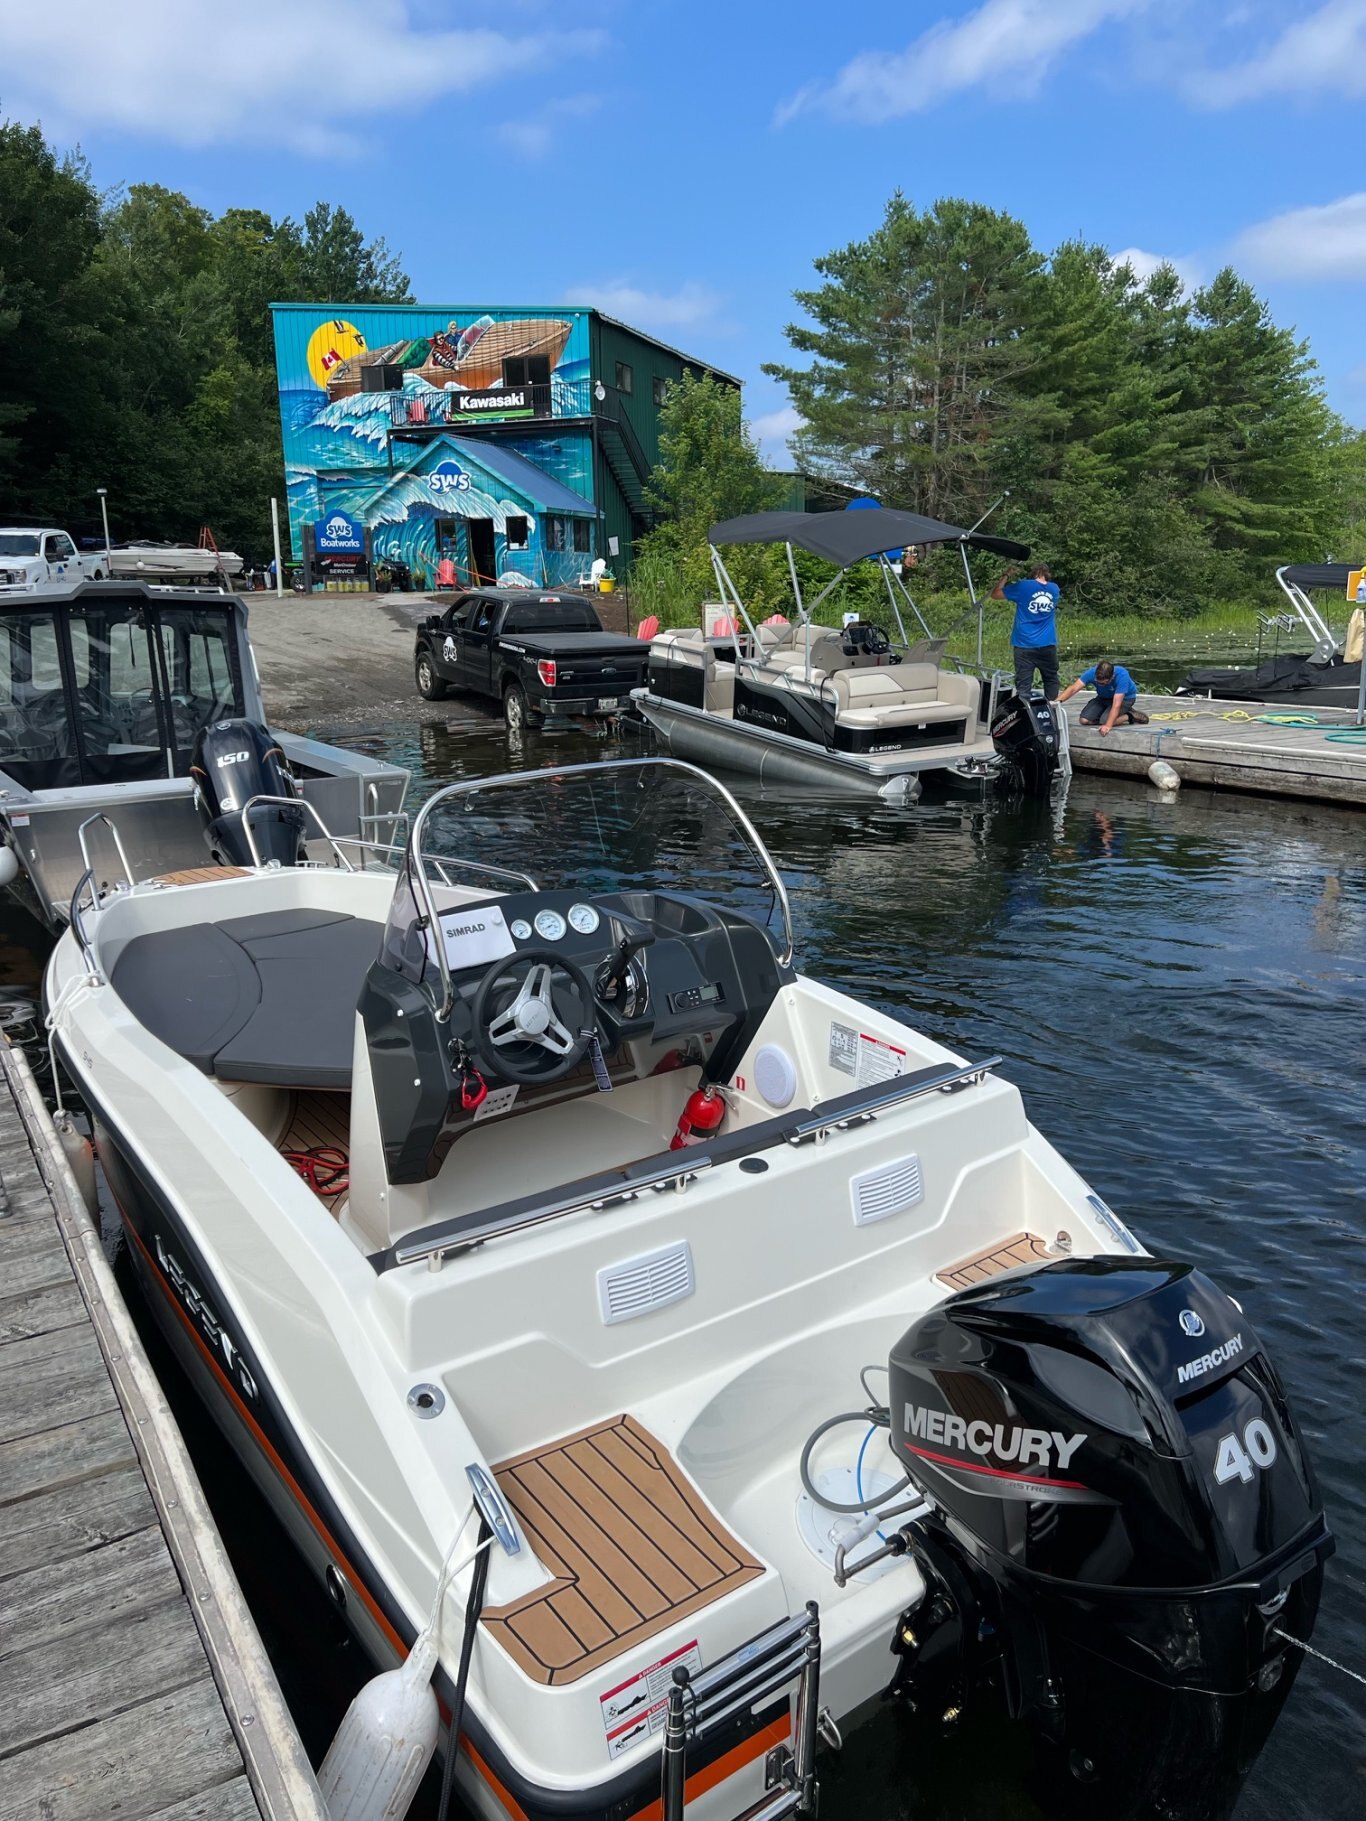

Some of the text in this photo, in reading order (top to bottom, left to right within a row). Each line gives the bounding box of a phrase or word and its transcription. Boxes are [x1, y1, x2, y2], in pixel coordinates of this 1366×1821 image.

[460, 392, 525, 410] Kawasaki
[429, 472, 470, 492] SWS
[327, 524, 352, 537] SWS
[320, 538, 360, 547] Boatworks
[1029, 601, 1054, 612] SWS
[745, 709, 787, 726] LEGEND
[1037, 711, 1050, 719] 40
[876, 744, 902, 752] LEGEND
[217, 751, 249, 768] 150
[446, 923, 486, 938] SIMRAD
[1177, 1333, 1244, 1383] MERCURY
[904, 1402, 1088, 1469] MERCURY
[1213, 1416, 1277, 1486] 40
[642, 1662, 662, 1676] DANGER
